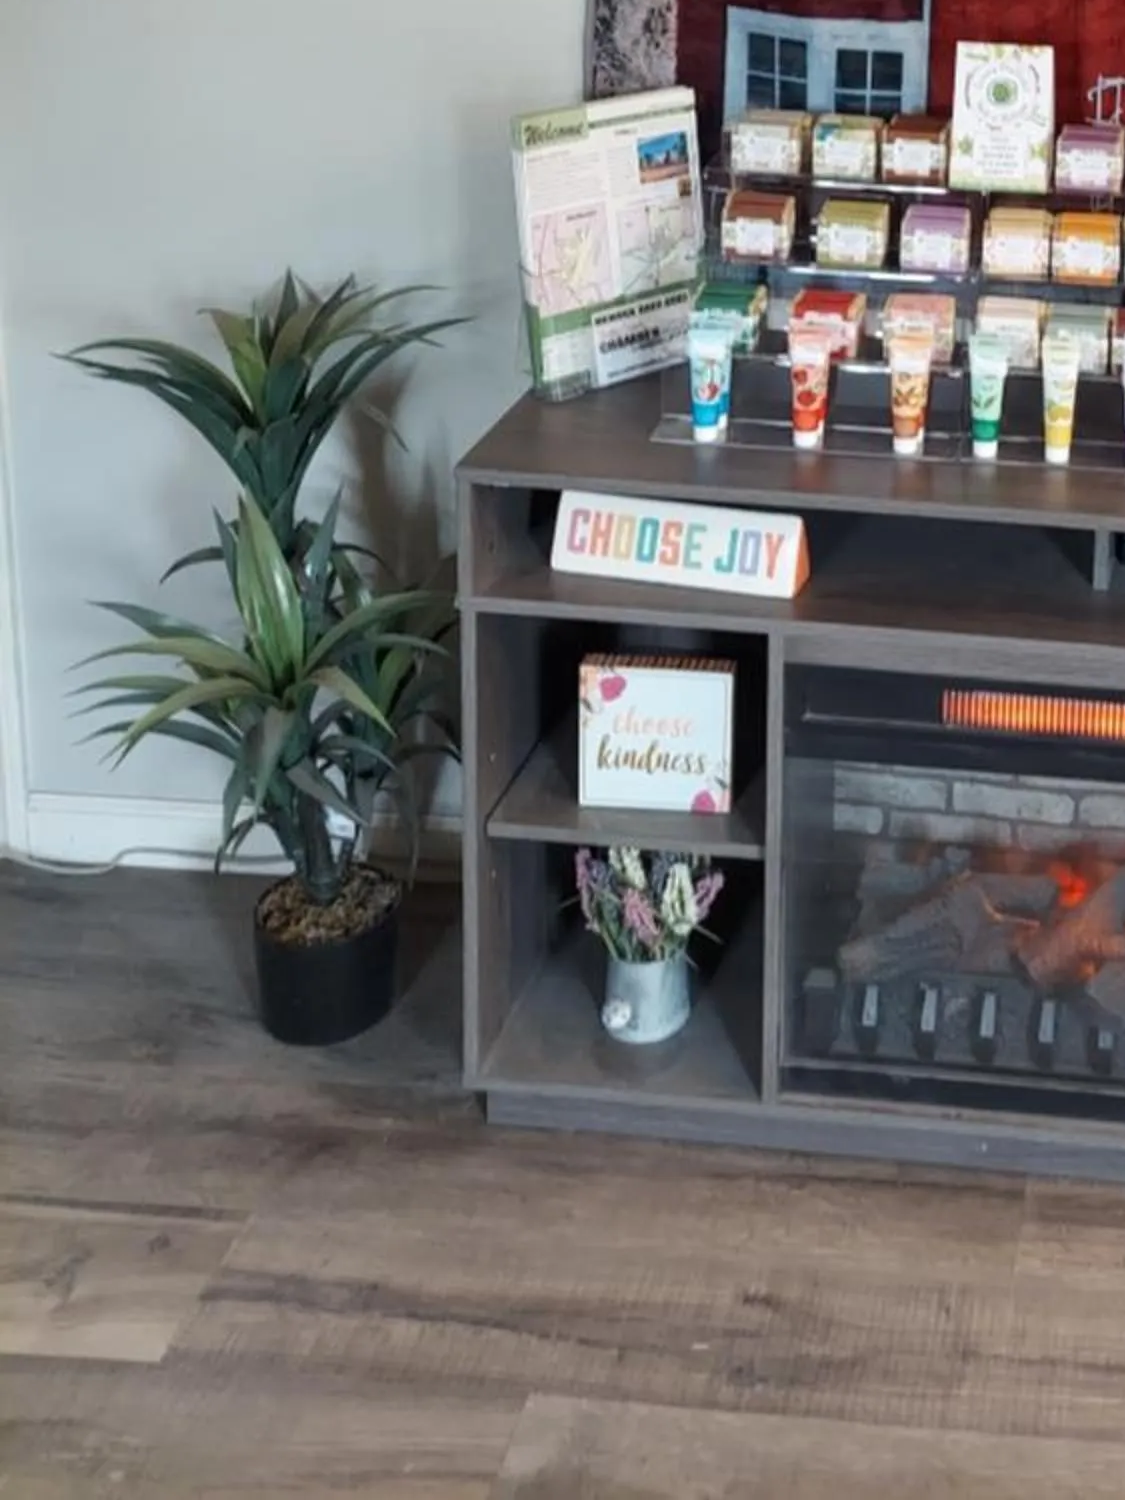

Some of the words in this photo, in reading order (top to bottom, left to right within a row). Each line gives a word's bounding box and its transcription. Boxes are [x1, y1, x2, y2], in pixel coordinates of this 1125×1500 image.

[566, 508, 707, 569] CHOOSE
[714, 528, 784, 580] JOY
[612, 705, 693, 738] choose
[597, 733, 708, 775] kindness
